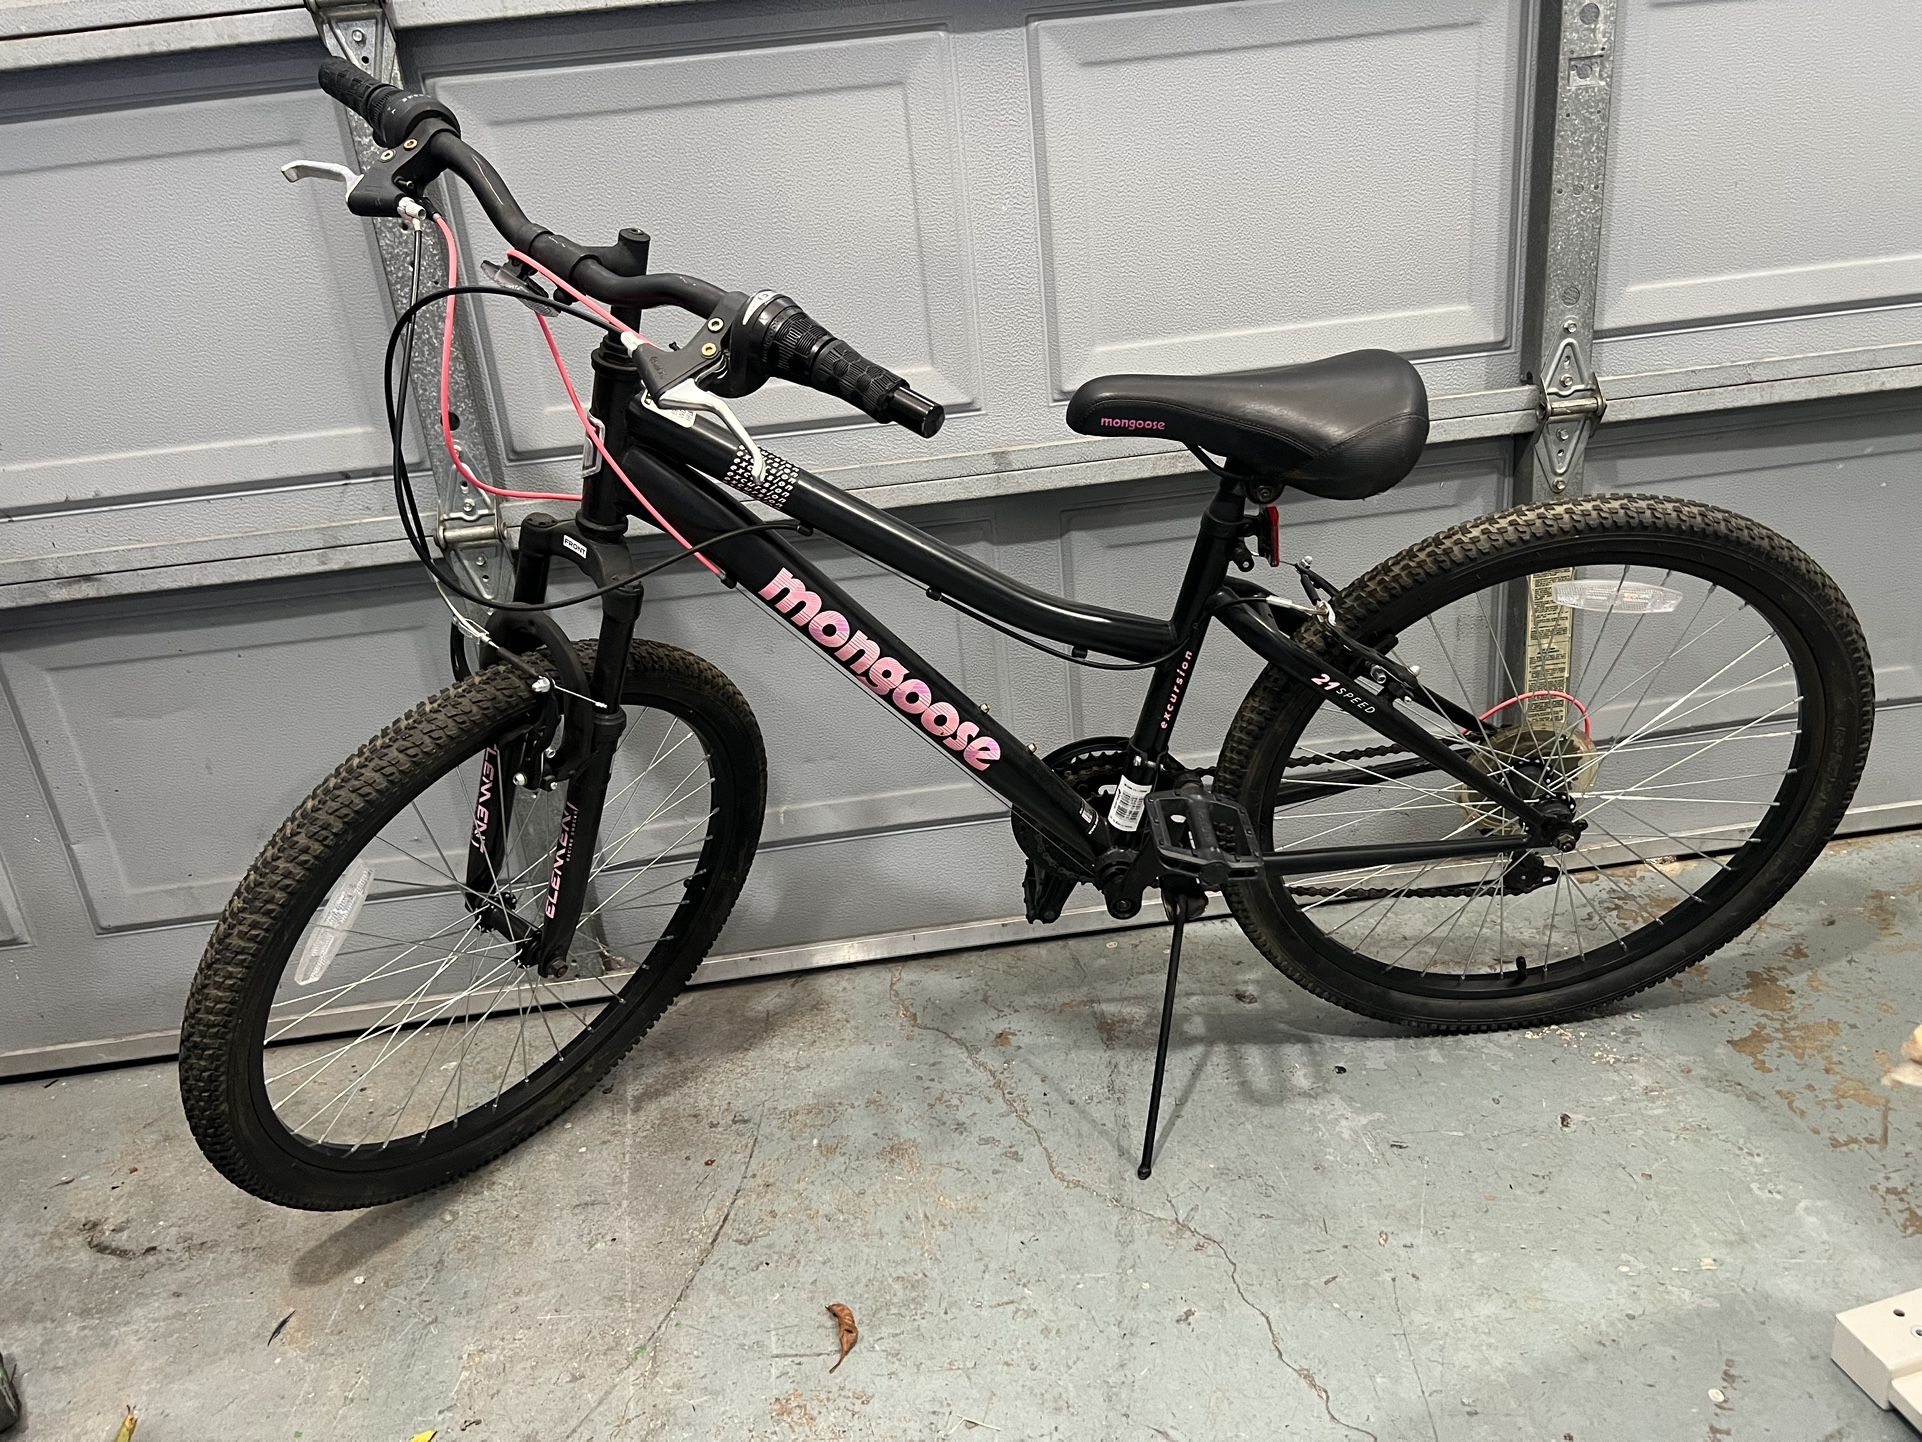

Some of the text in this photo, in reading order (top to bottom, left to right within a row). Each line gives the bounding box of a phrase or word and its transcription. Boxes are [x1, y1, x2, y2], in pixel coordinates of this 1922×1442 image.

[1100, 417, 1166, 430] mongoose
[726, 470, 787, 503] excursion
[564, 538, 586, 556] FRONT
[758, 567, 1001, 771] mongoose
[1161, 650, 1193, 729] excursion
[1311, 673, 1376, 713] 21 SPEED
[471, 744, 498, 854] LEMENT
